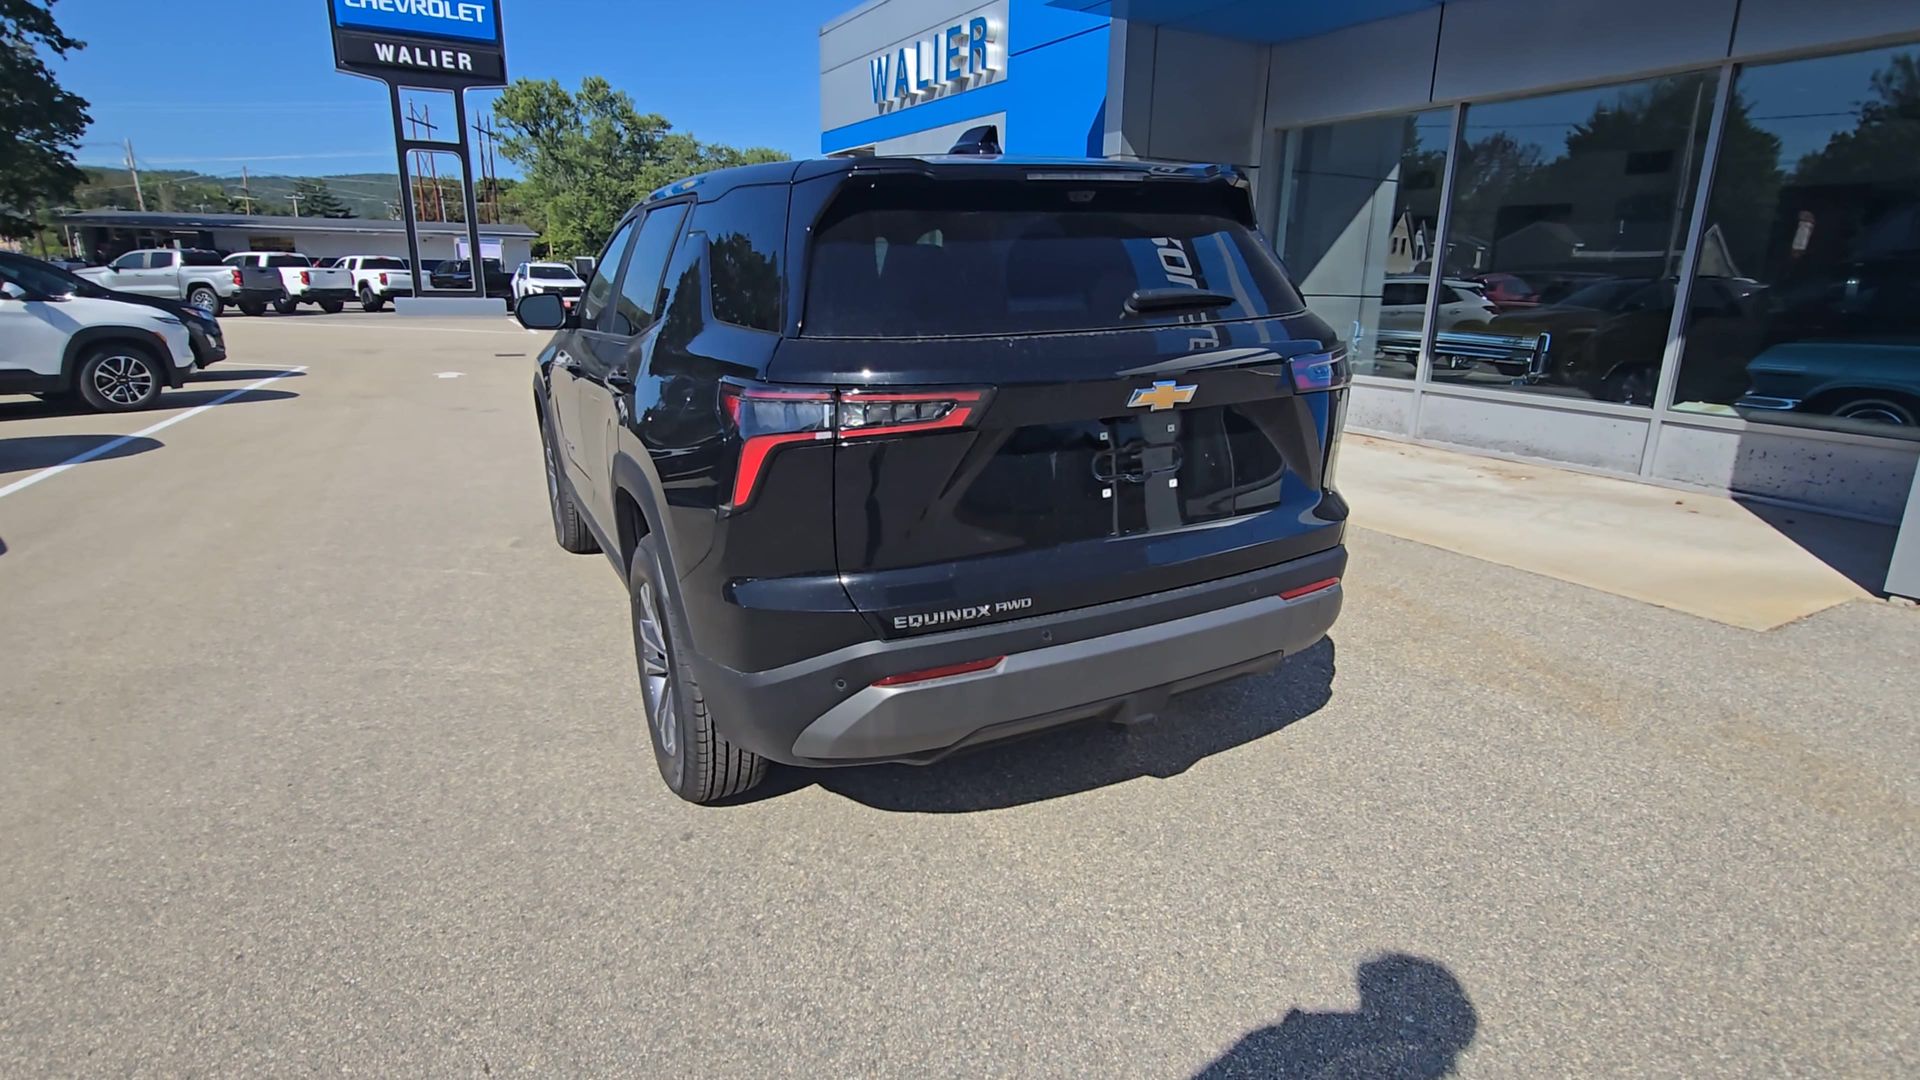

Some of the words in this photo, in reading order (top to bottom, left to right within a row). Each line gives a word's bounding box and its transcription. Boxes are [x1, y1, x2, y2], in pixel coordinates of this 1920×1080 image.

[374, 42, 473, 71] WALIER
[870, 16, 988, 104] WALIER
[893, 604, 991, 629] EQUINOX
[995, 597, 1033, 613] AWD
